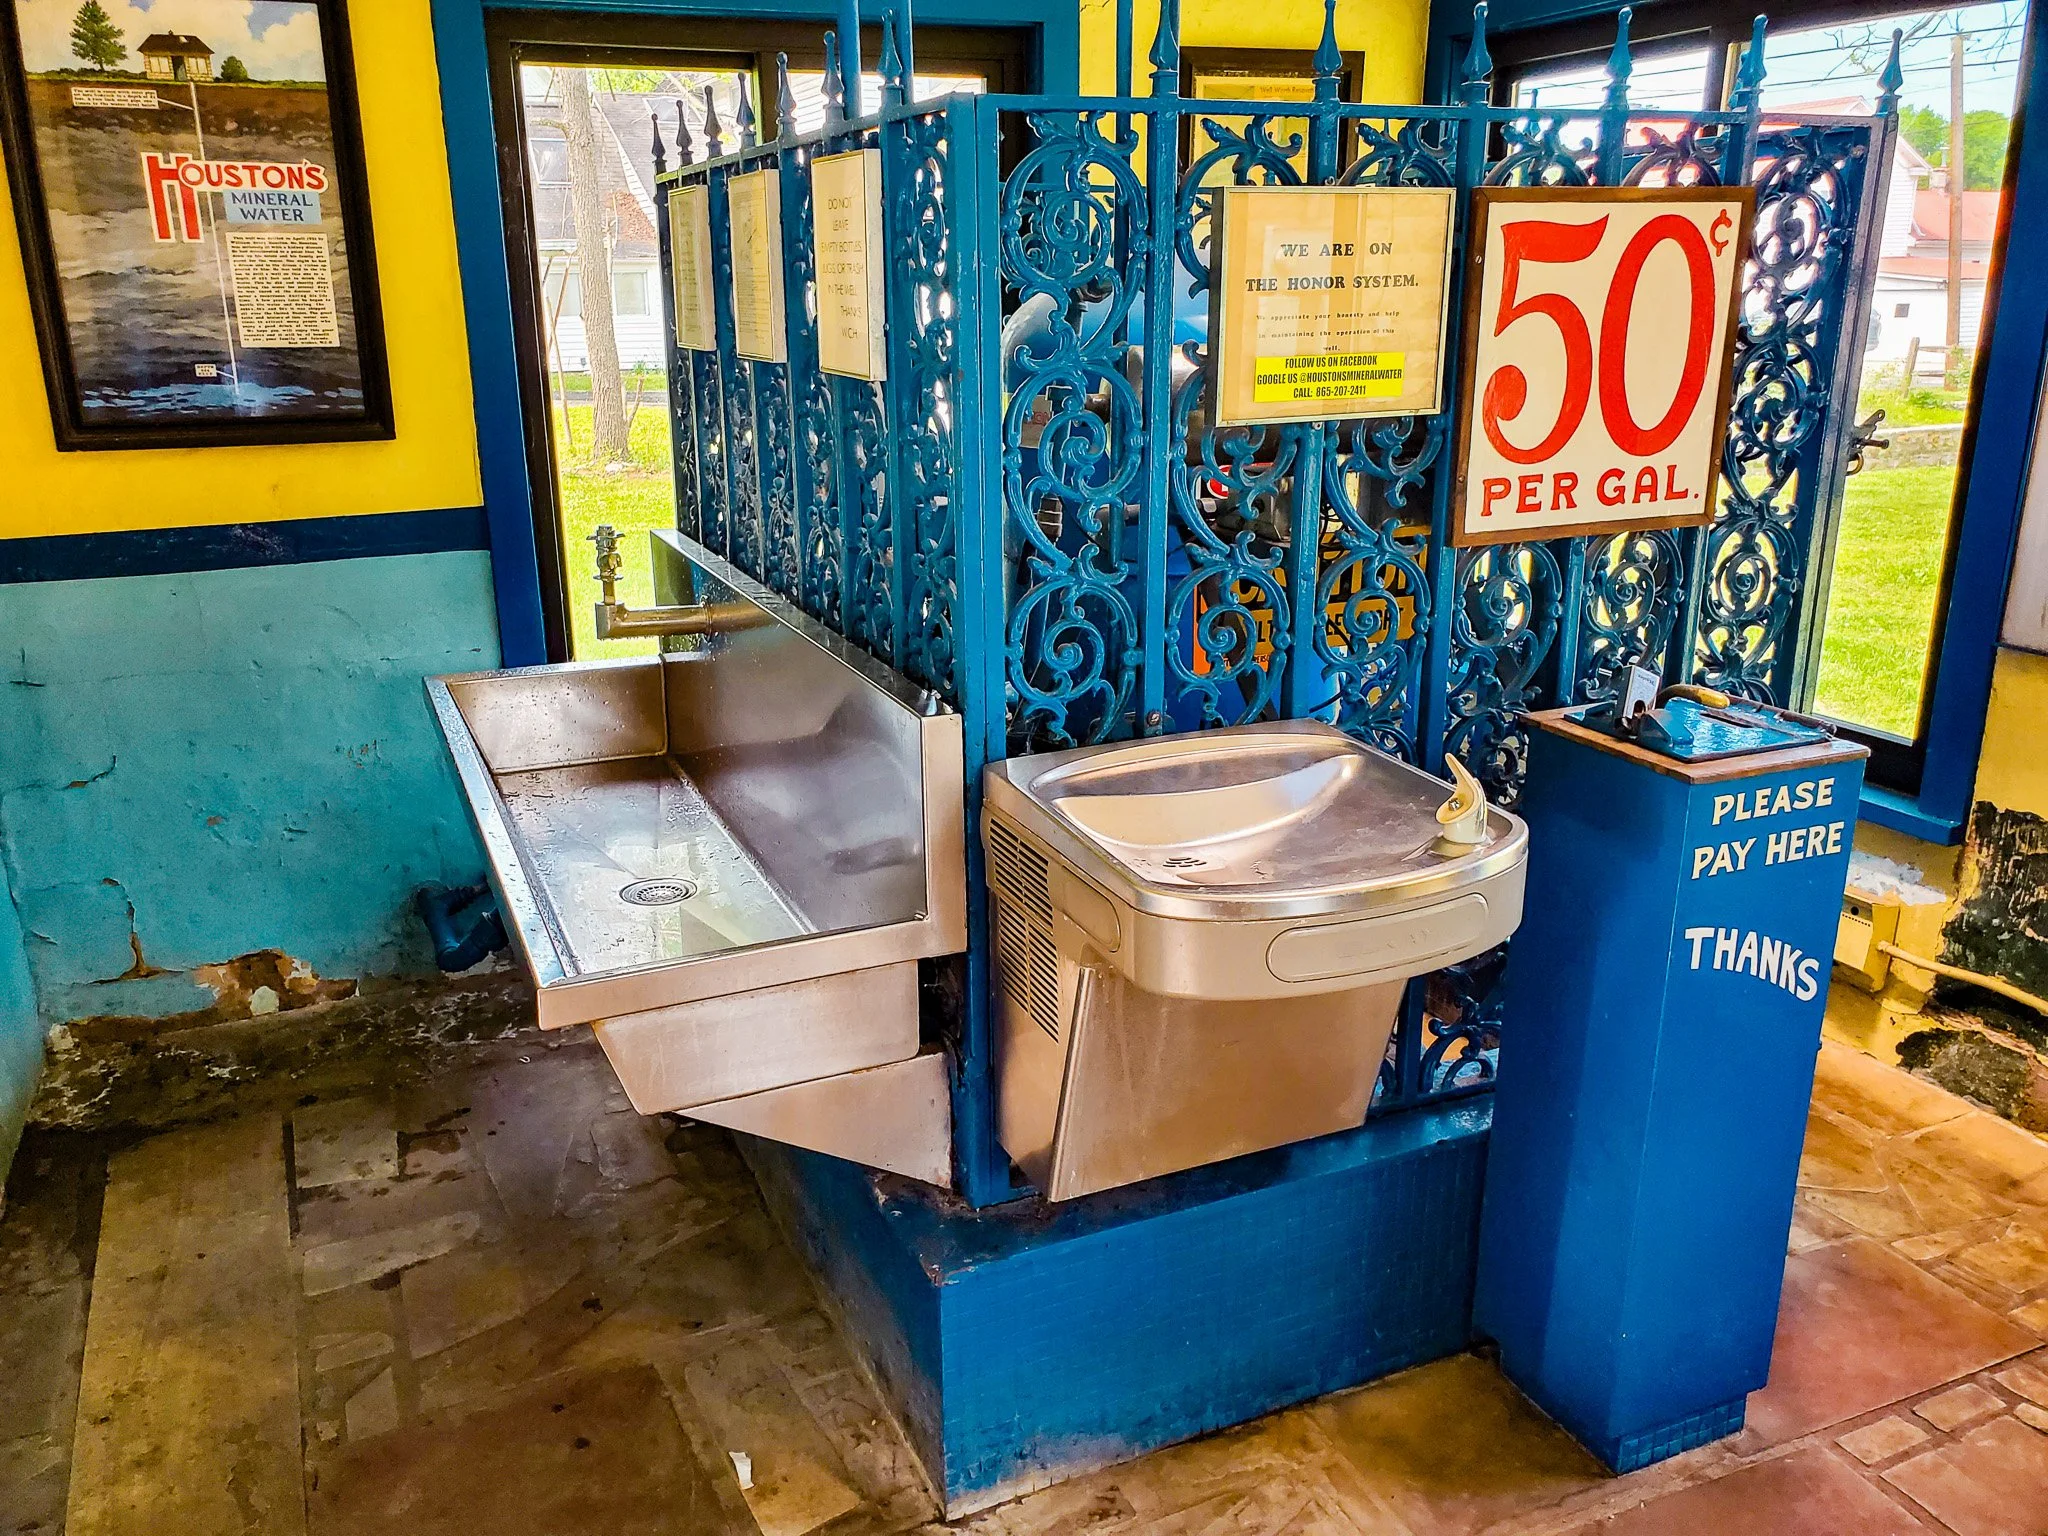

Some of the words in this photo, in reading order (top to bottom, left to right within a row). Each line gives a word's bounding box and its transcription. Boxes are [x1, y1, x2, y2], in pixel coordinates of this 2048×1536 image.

[146, 155, 325, 240] HOUSTON'S
[231, 191, 314, 207] MINERAL
[827, 198, 838, 210] DO
[839, 196, 853, 209] NOT
[240, 207, 305, 222] WATER
[832, 218, 849, 231] LEAVE
[1281, 243, 1309, 257] WE
[1319, 243, 1354, 257] ARE
[1369, 242, 1393, 255] ON
[837, 262, 846, 274] OR
[846, 262, 864, 275] TRASH
[834, 283, 844, 296] THE
[845, 284, 858, 296] WELL
[1245, 278, 1278, 292] THE
[1287, 276, 1346, 291] HONOR
[1352, 274, 1419, 289] SYSTEM.
[840, 305, 862, 318] THANKS
[1270, 313, 1310, 321] appreciate
[1271, 330, 1315, 338] maintaining
[1336, 328, 1371, 337] operation
[1285, 358, 1315, 369] FOLLOW
[1315, 357, 1327, 368] US
[1327, 356, 1338, 367] ON
[1339, 355, 1378, 367] FACEBOOK
[1257, 374, 1286, 385] GOOGLE
[1287, 373, 1298, 384] US
[1299, 369, 1403, 384] @HOUSTONSMINERALWATER
[1293, 387, 1313, 399] CALL:
[1315, 385, 1367, 397] 865-207-2411
[1480, 472, 1579, 517] PER
[1596, 464, 1700, 507] GAL.
[1711, 777, 1836, 826] PLEASE
[1690, 836, 1758, 881] PAY
[1764, 820, 1846, 867] HERE
[1683, 926, 1821, 1002] THANKS
